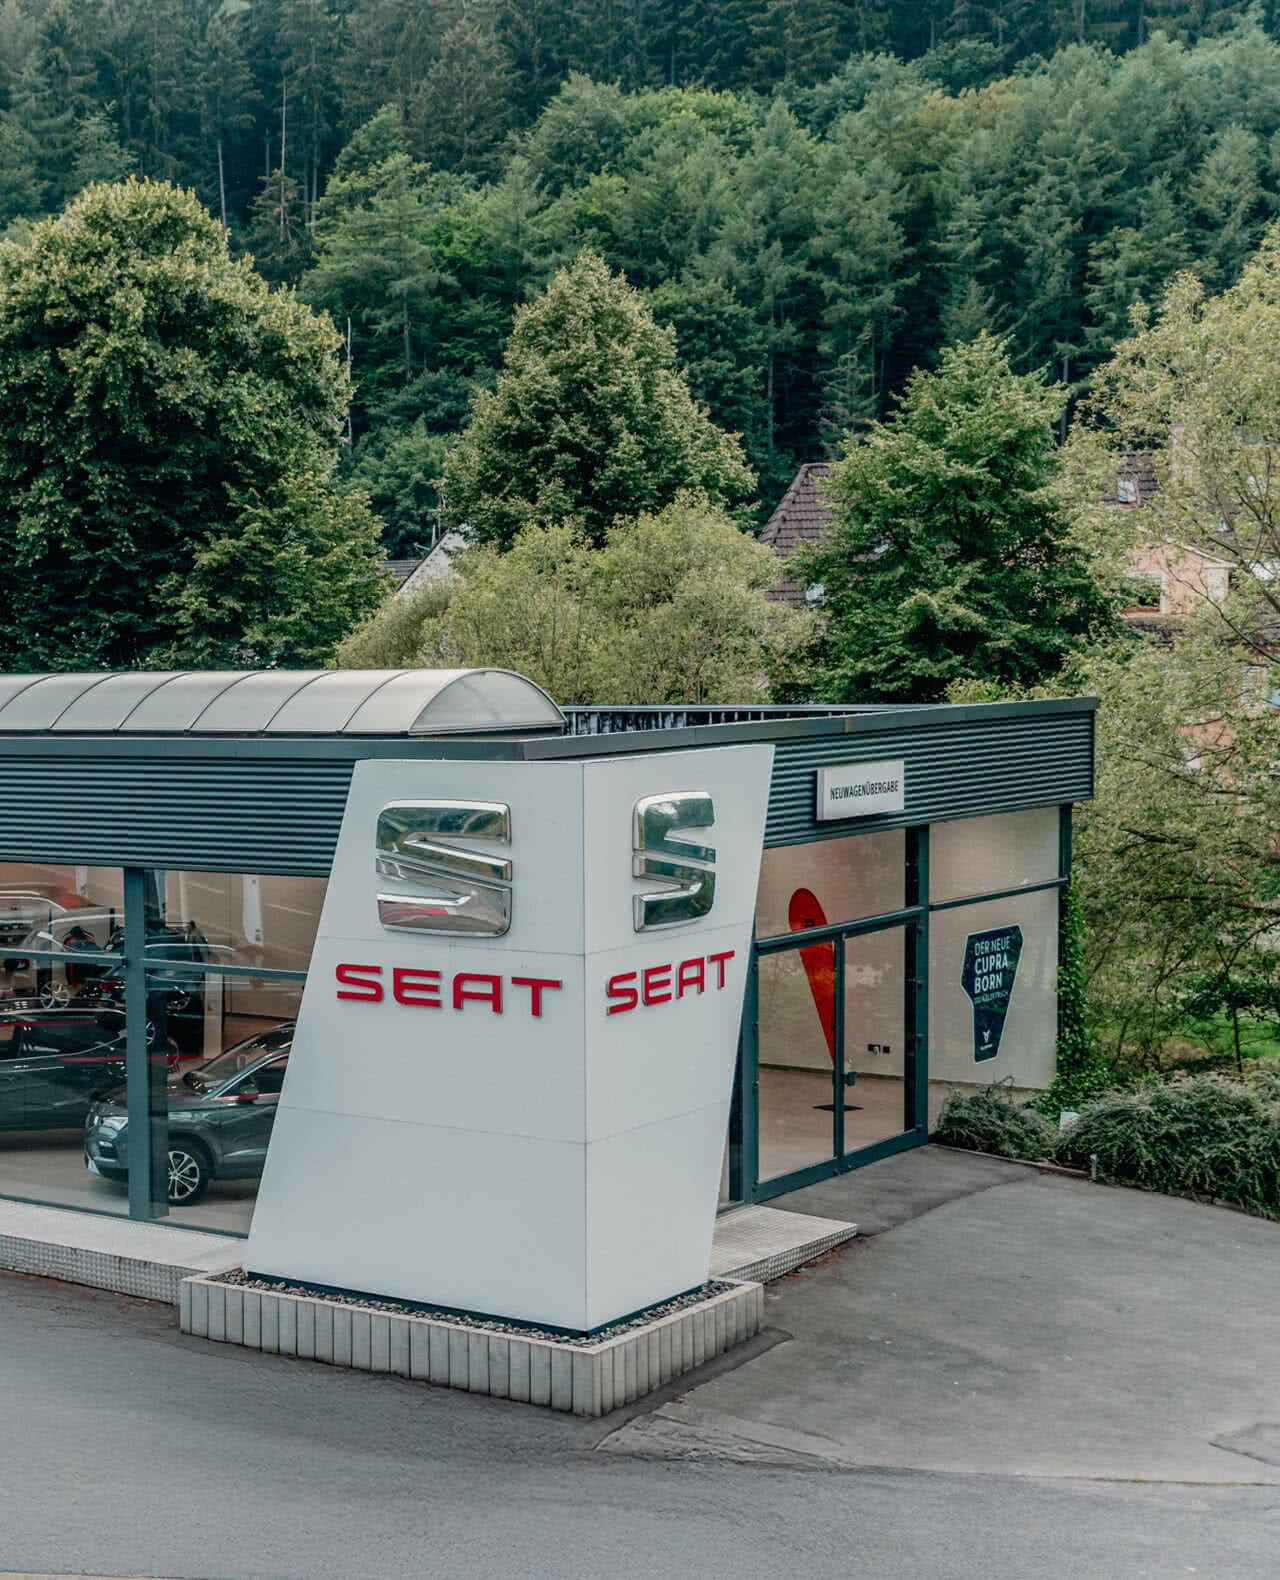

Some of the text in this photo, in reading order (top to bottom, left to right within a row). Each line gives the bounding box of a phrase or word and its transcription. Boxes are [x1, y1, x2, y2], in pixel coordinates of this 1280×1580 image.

[830, 780, 899, 801] NEUWAGENÜBERGABE
[974, 936, 1010, 956] DER NEUE
[974, 952, 1009, 975] CUPRA
[335, 963, 562, 1017] SEAT
[606, 950, 735, 1016] SEAT
[974, 972, 1003, 994] BORN
